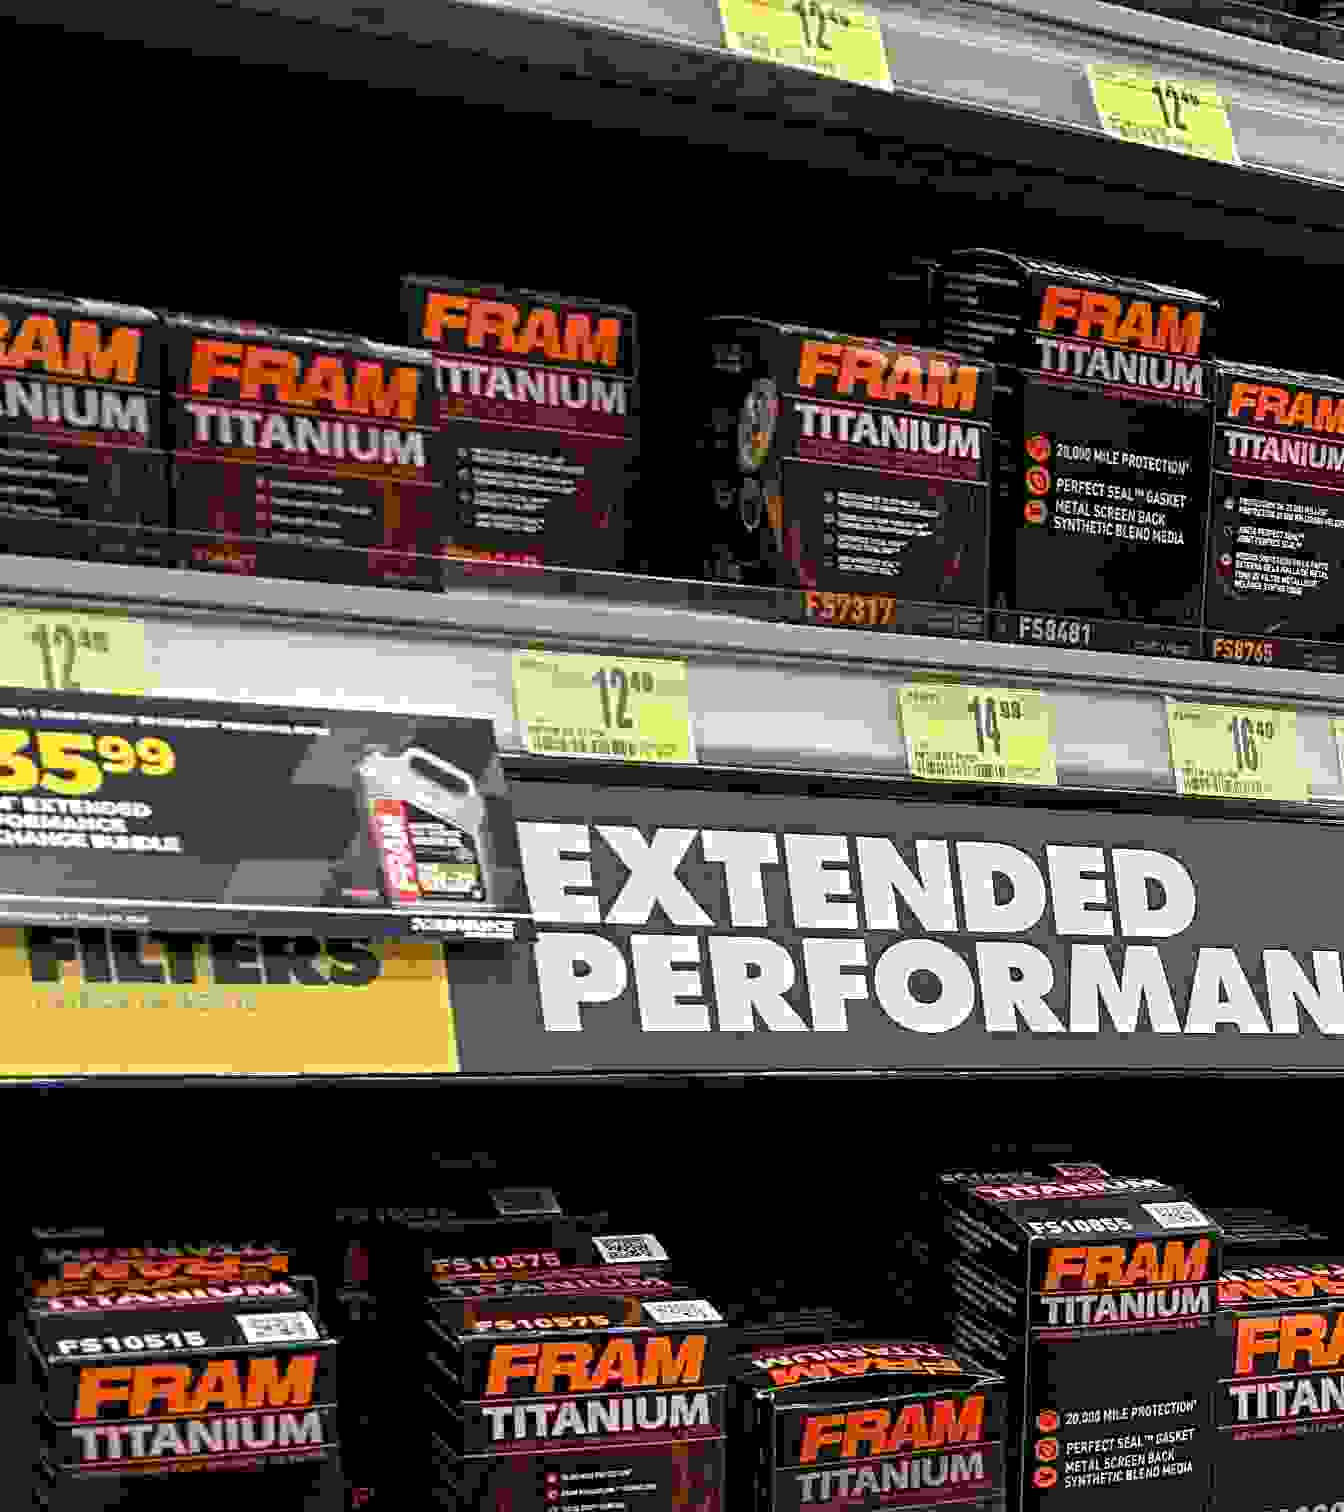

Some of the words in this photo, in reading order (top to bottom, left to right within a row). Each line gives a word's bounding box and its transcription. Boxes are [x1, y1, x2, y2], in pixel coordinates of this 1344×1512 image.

[422, 291, 621, 366] FRAM
[1039, 287, 1203, 357] FRAM
[190, 337, 418, 421] FRAM
[435, 363, 627, 416] TITANIUM
[799, 338, 978, 413] FRAM
[1036, 338, 1203, 395] TITANIUM
[185, 401, 425, 466] TITANIUM
[794, 404, 982, 458] TITANIUM
[1018, 616, 1095, 644] FS8481
[515, 819, 1197, 938] EXTENDED
[1042, 1239, 1211, 1296] FRAM
[1040, 1289, 1210, 1325] TITANIUM
[74, 1353, 319, 1425] FRAM
[483, 1336, 706, 1403] FRAM
[72, 1412, 324, 1461] TITANIUM
[482, 1393, 712, 1440] TITANIUM
[800, 1394, 986, 1465] FRAM
